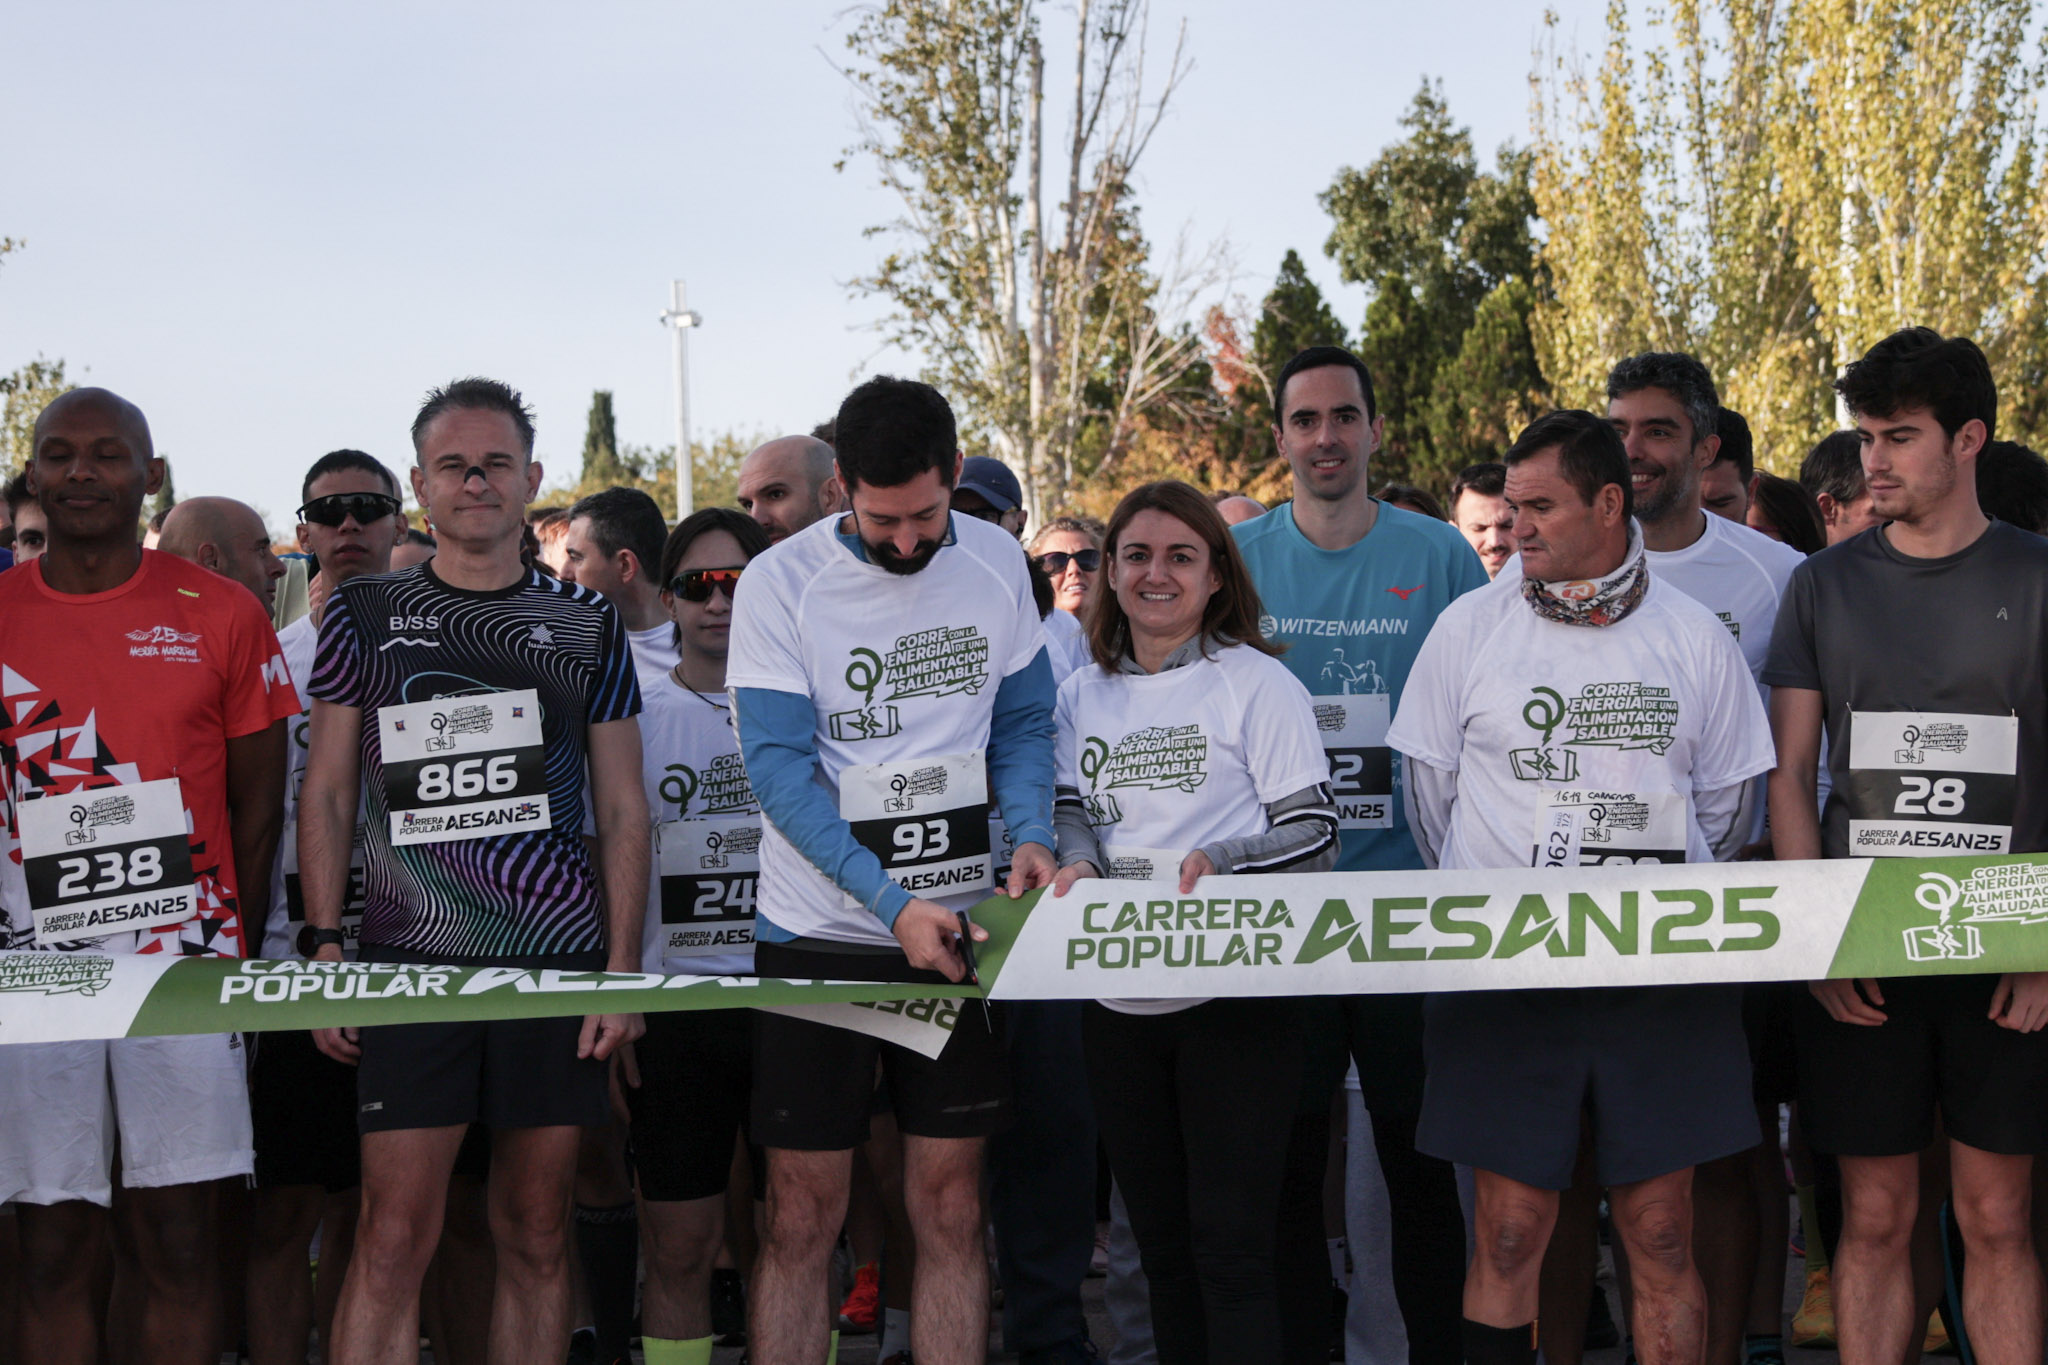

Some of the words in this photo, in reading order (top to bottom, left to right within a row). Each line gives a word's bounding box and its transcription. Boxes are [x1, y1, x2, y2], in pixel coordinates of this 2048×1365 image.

[389, 615, 440, 631] B/SS
[1280, 617, 1409, 637] WITZENMANN
[151, 626, 180, 643] 25
[896, 627, 948, 651] CORRE
[949, 630, 965, 639] CON
[965, 627, 977, 636] LA
[887, 641, 952, 668] ENERGIA
[955, 643, 967, 652] DE
[968, 638, 987, 650] UNA
[888, 648, 987, 682] ALIMENTACIÓN
[896, 663, 981, 694] SALUDABLE
[1582, 683, 1641, 698] CORRE
[1641, 688, 1657, 696] CON
[1658, 688, 1670, 697] LA
[1569, 696, 1642, 713] ENERGIA
[1646, 701, 1659, 710] DE
[1660, 702, 1678, 710] UNA
[1569, 709, 1677, 727] ALIMENTACIÓN
[1122, 727, 1172, 744] CORRE
[1172, 727, 1187, 736] CON
[1188, 725, 1198, 734] LA
[1576, 723, 1670, 740] SALUDABLE
[1112, 737, 1171, 758] ENERGIA
[1175, 739, 1187, 749] DE
[1187, 737, 1206, 748] UNA
[1108, 747, 1206, 771] ALIMENTACIÓN
[416, 754, 519, 802] 866
[1113, 760, 1199, 783] SALUDABLE
[1326, 754, 1364, 789] 2
[1893, 775, 1967, 816] 28
[445, 804, 541, 832] AESAN25
[400, 824, 443, 836] POPULAR
[890, 818, 950, 862] 93
[1859, 829, 1899, 839] CARRERA
[1898, 830, 2003, 851] AESAN25
[1856, 837, 1897, 847] POPULAR
[57, 845, 164, 899] 238
[899, 863, 985, 891] AESAN25
[1973, 864, 2030, 879] CORRE
[1964, 874, 2036, 892] ENERGIA
[693, 878, 759, 916] 24
[44, 911, 87, 926] CARRERA
[87, 895, 188, 927] AESAN25
[1082, 897, 1296, 935] CARRERA
[42, 920, 85, 934] POPULAR
[672, 930, 713, 940] CARRERA
[1292, 885, 1782, 964] AESAN25
[669, 938, 710, 948] POPULAR
[1066, 932, 1284, 971] POPULAR
[240, 959, 463, 975] CARRERA
[0, 970, 102, 988] SALUDABLE
[219, 972, 449, 1004] POPULAR
